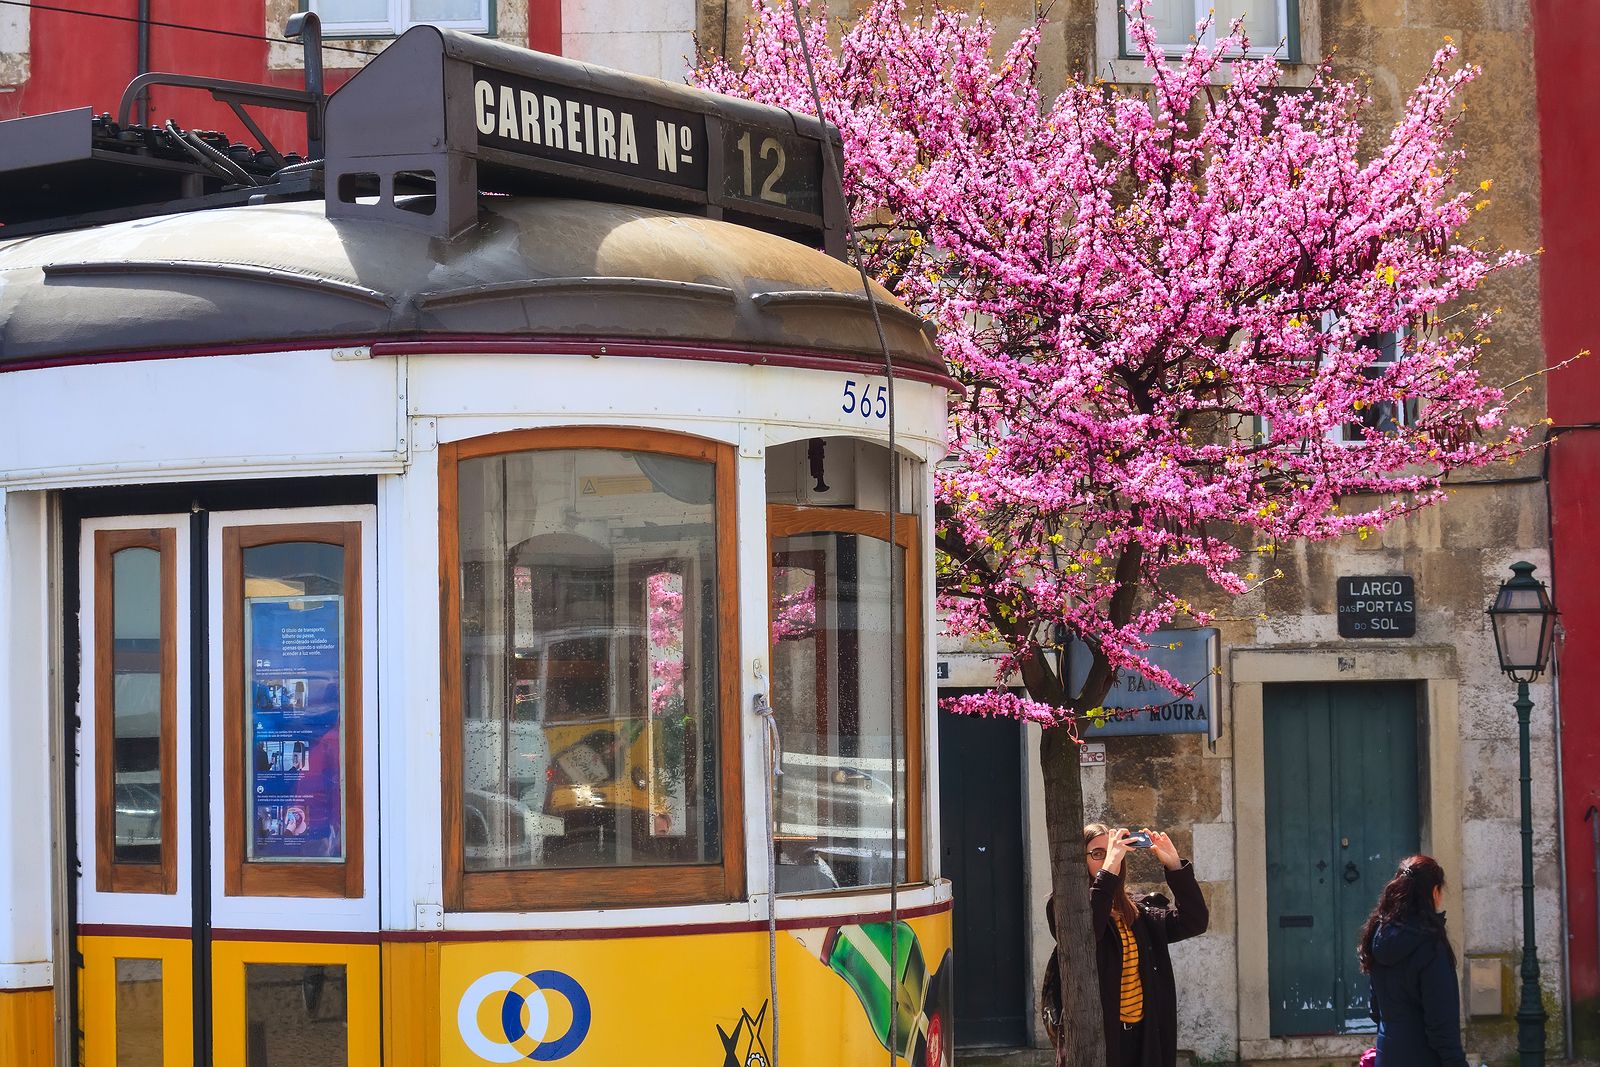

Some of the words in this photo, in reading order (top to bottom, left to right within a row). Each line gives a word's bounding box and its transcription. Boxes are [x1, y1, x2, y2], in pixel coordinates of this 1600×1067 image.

[474, 80, 639, 165] CARREIRA
[656, 120, 693, 173] Nº
[737, 131, 787, 205] 12
[842, 380, 887, 419] 565
[1350, 581, 1402, 596] LARGO
[1339, 605, 1357, 613] DAS
[1357, 601, 1413, 613] PORTAS
[1355, 622, 1367, 630] DO
[1371, 618, 1400, 630] SOL
[1150, 703, 1208, 723] MOURA
